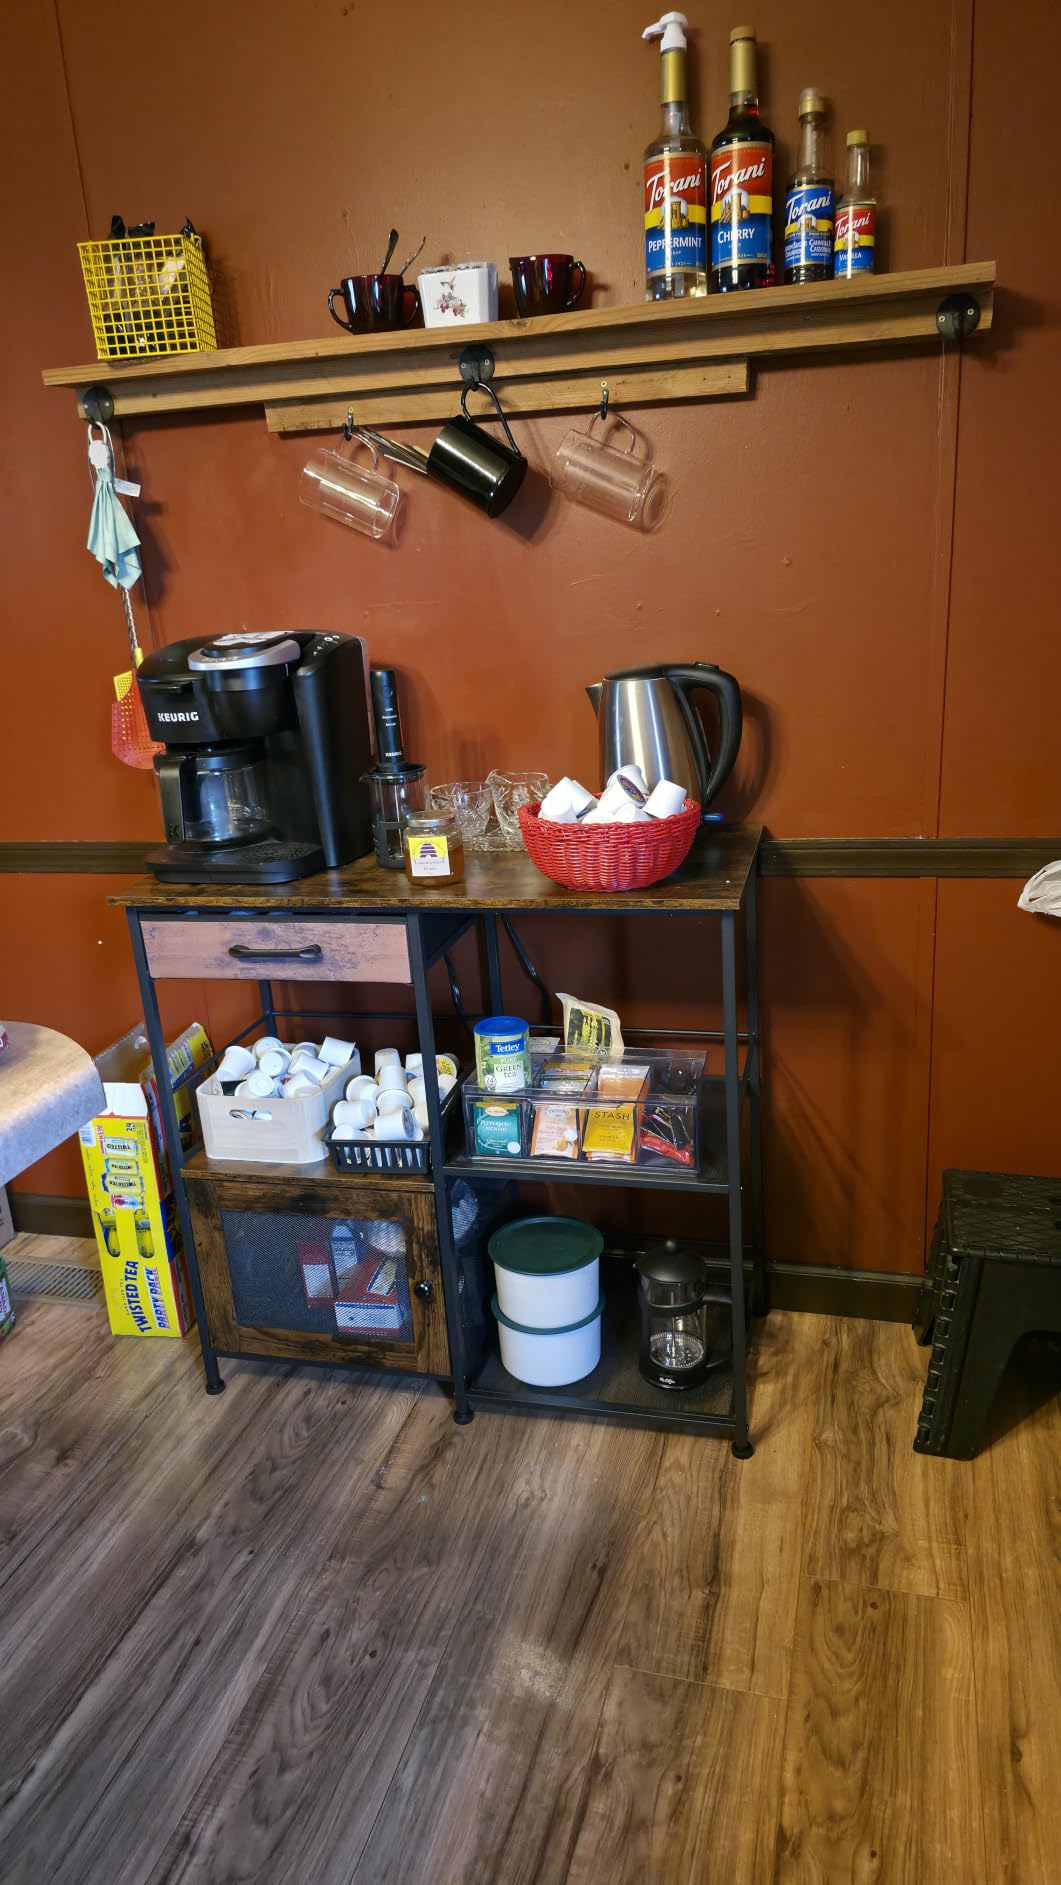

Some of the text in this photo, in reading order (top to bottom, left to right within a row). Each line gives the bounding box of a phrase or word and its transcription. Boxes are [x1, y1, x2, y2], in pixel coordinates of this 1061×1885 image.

[712, 157, 765, 205] Torani
[646, 168, 701, 213] Torani
[786, 190, 831, 229] Torani
[835, 212, 870, 240] Torani
[648, 236, 702, 253] PEPPERMINT
[839, 251, 862, 261] VALLA
[157, 711, 199, 723] KEURIG
[495, 1043, 520, 1053] Tetley
[500, 1056, 517, 1064] PURE
[486, 1075, 495, 1084] 24
[594, 1111, 630, 1121] STASH
[124, 1260, 153, 1333] TWISTED TEA
[145, 1267, 170, 1329] PARTY PACK
